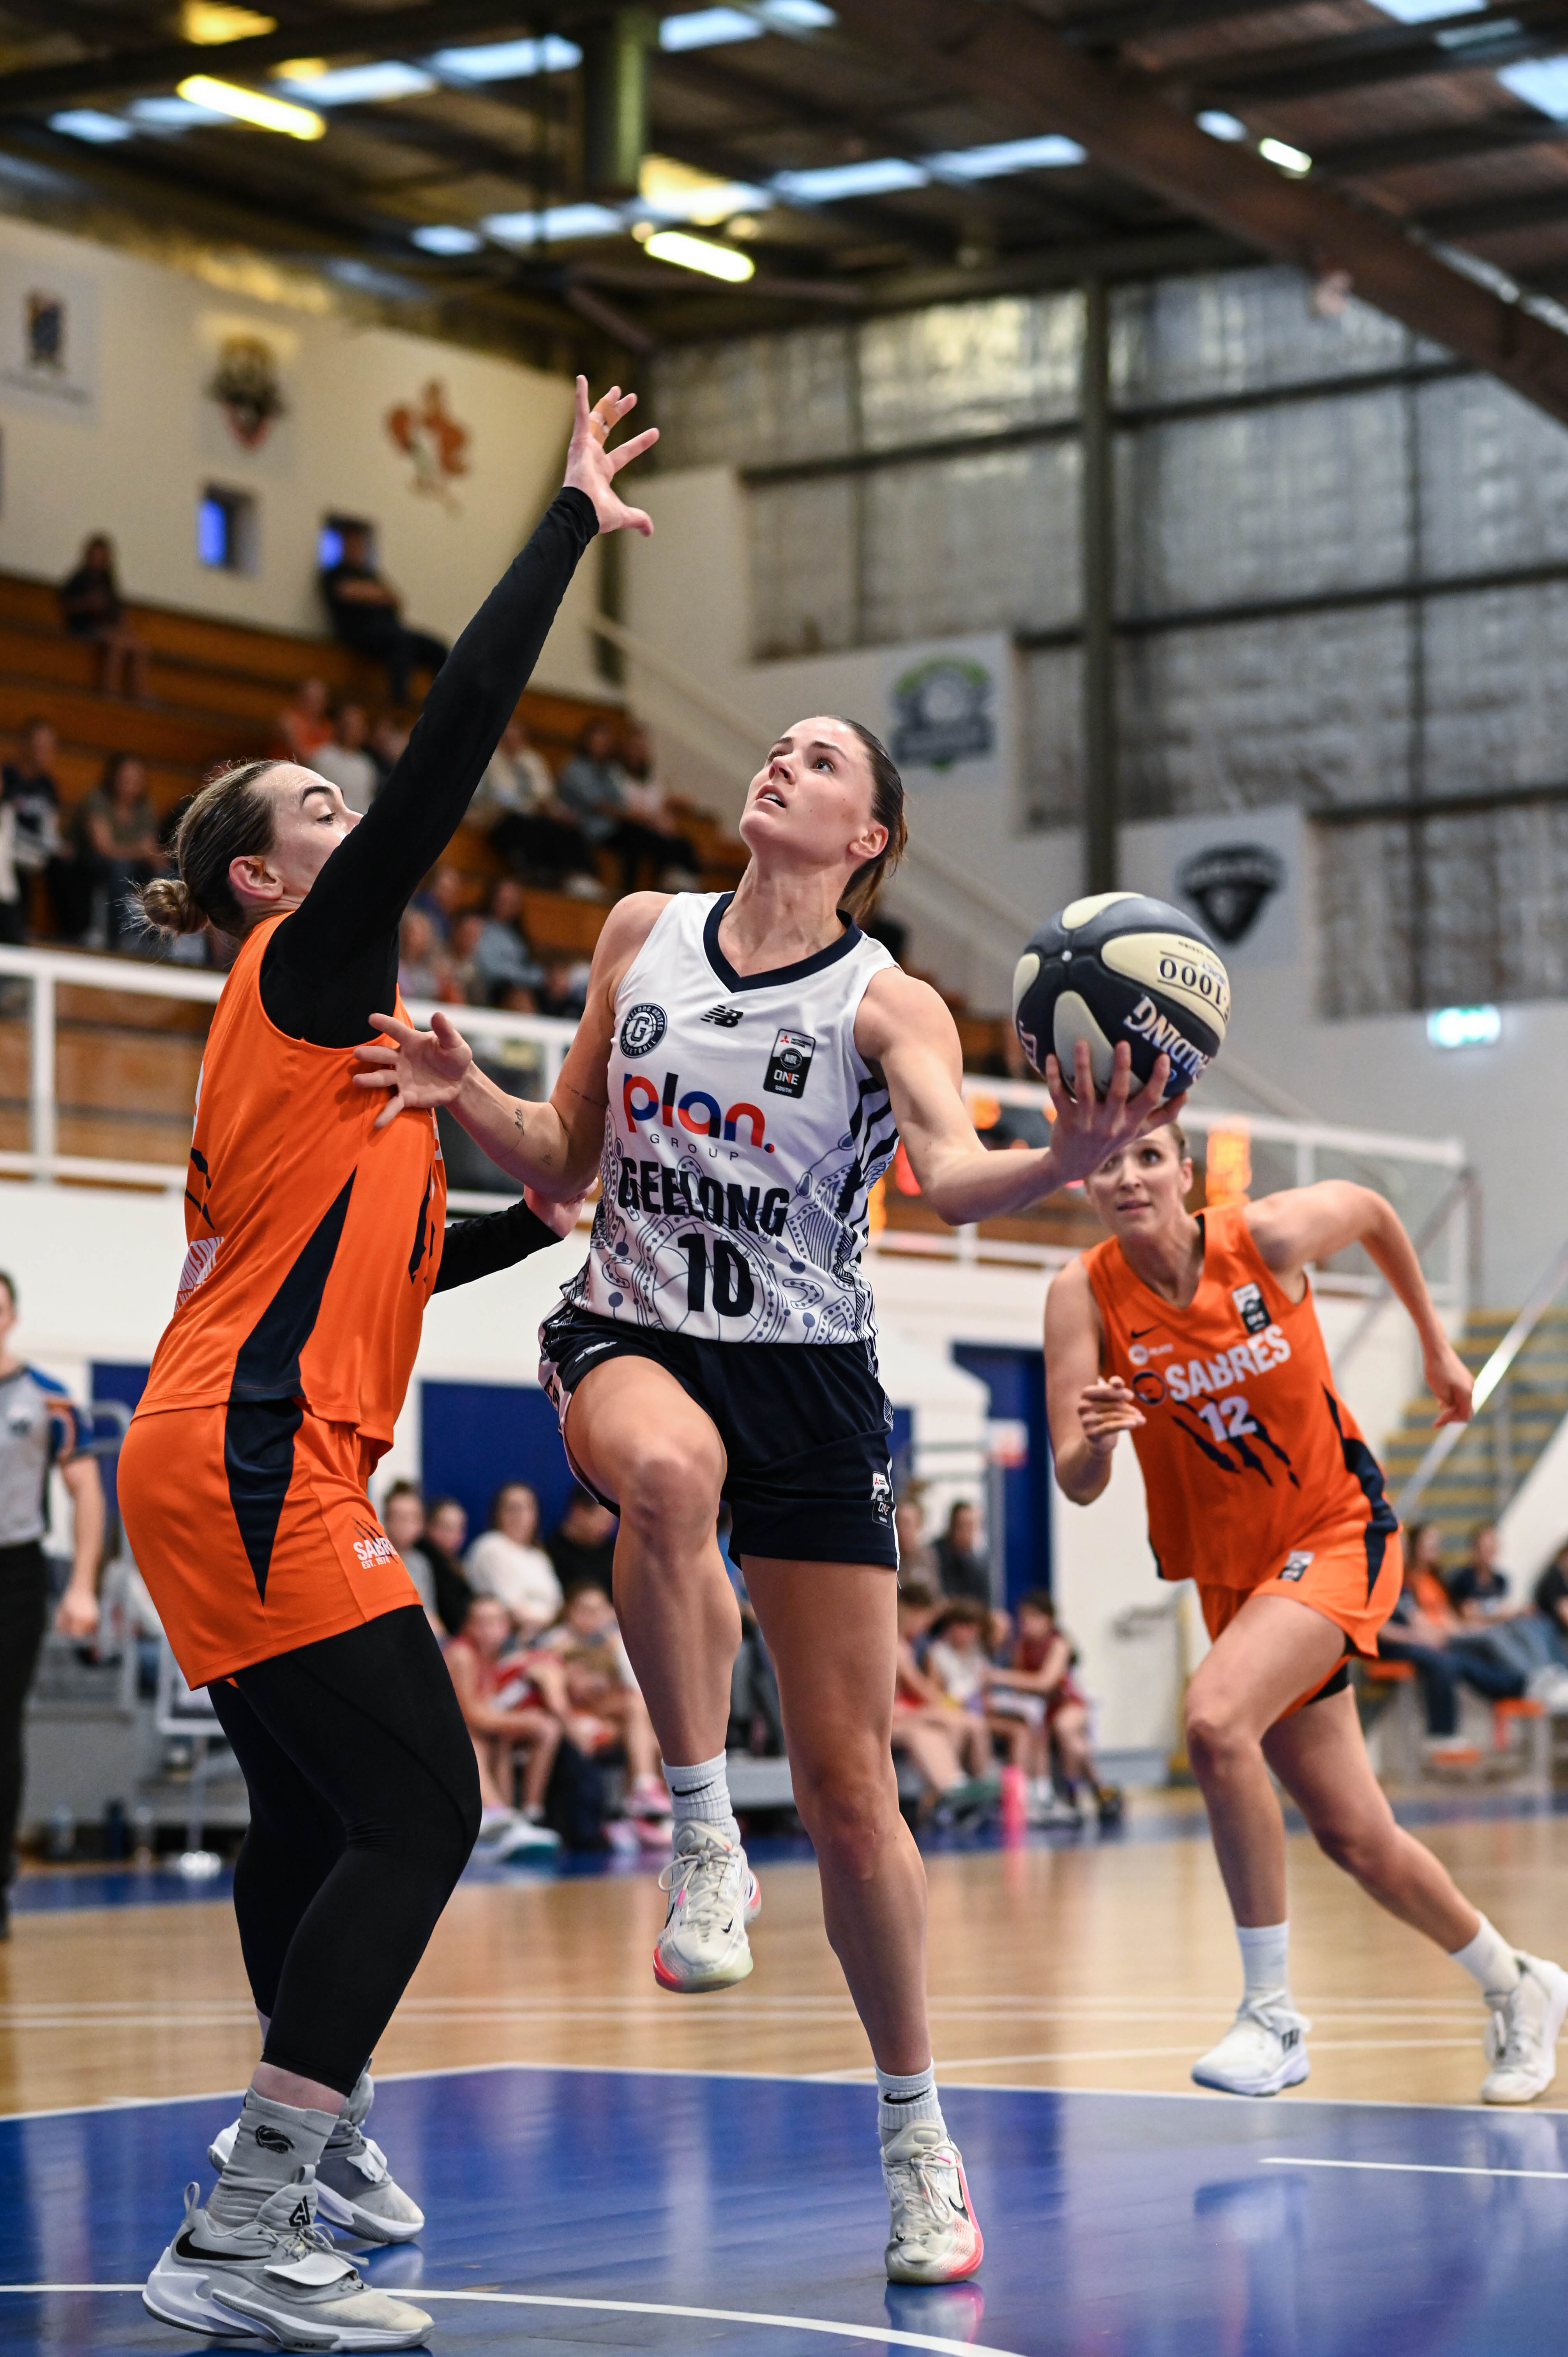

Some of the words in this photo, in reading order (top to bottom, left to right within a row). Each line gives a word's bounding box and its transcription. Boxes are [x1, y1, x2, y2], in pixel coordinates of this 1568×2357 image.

[630, 1016, 650, 1042] G
[773, 1069, 800, 1085] ONE
[650, 1134, 739, 1161] GROUP
[618, 1157, 790, 1237] GEELONG
[678, 1233, 754, 1317] 10
[1165, 1324, 1291, 1401] SABRES
[1198, 1396, 1258, 1442] 12
[878, 1502, 890, 1516] ONE
[361, 1559, 376, 1570] EST.
